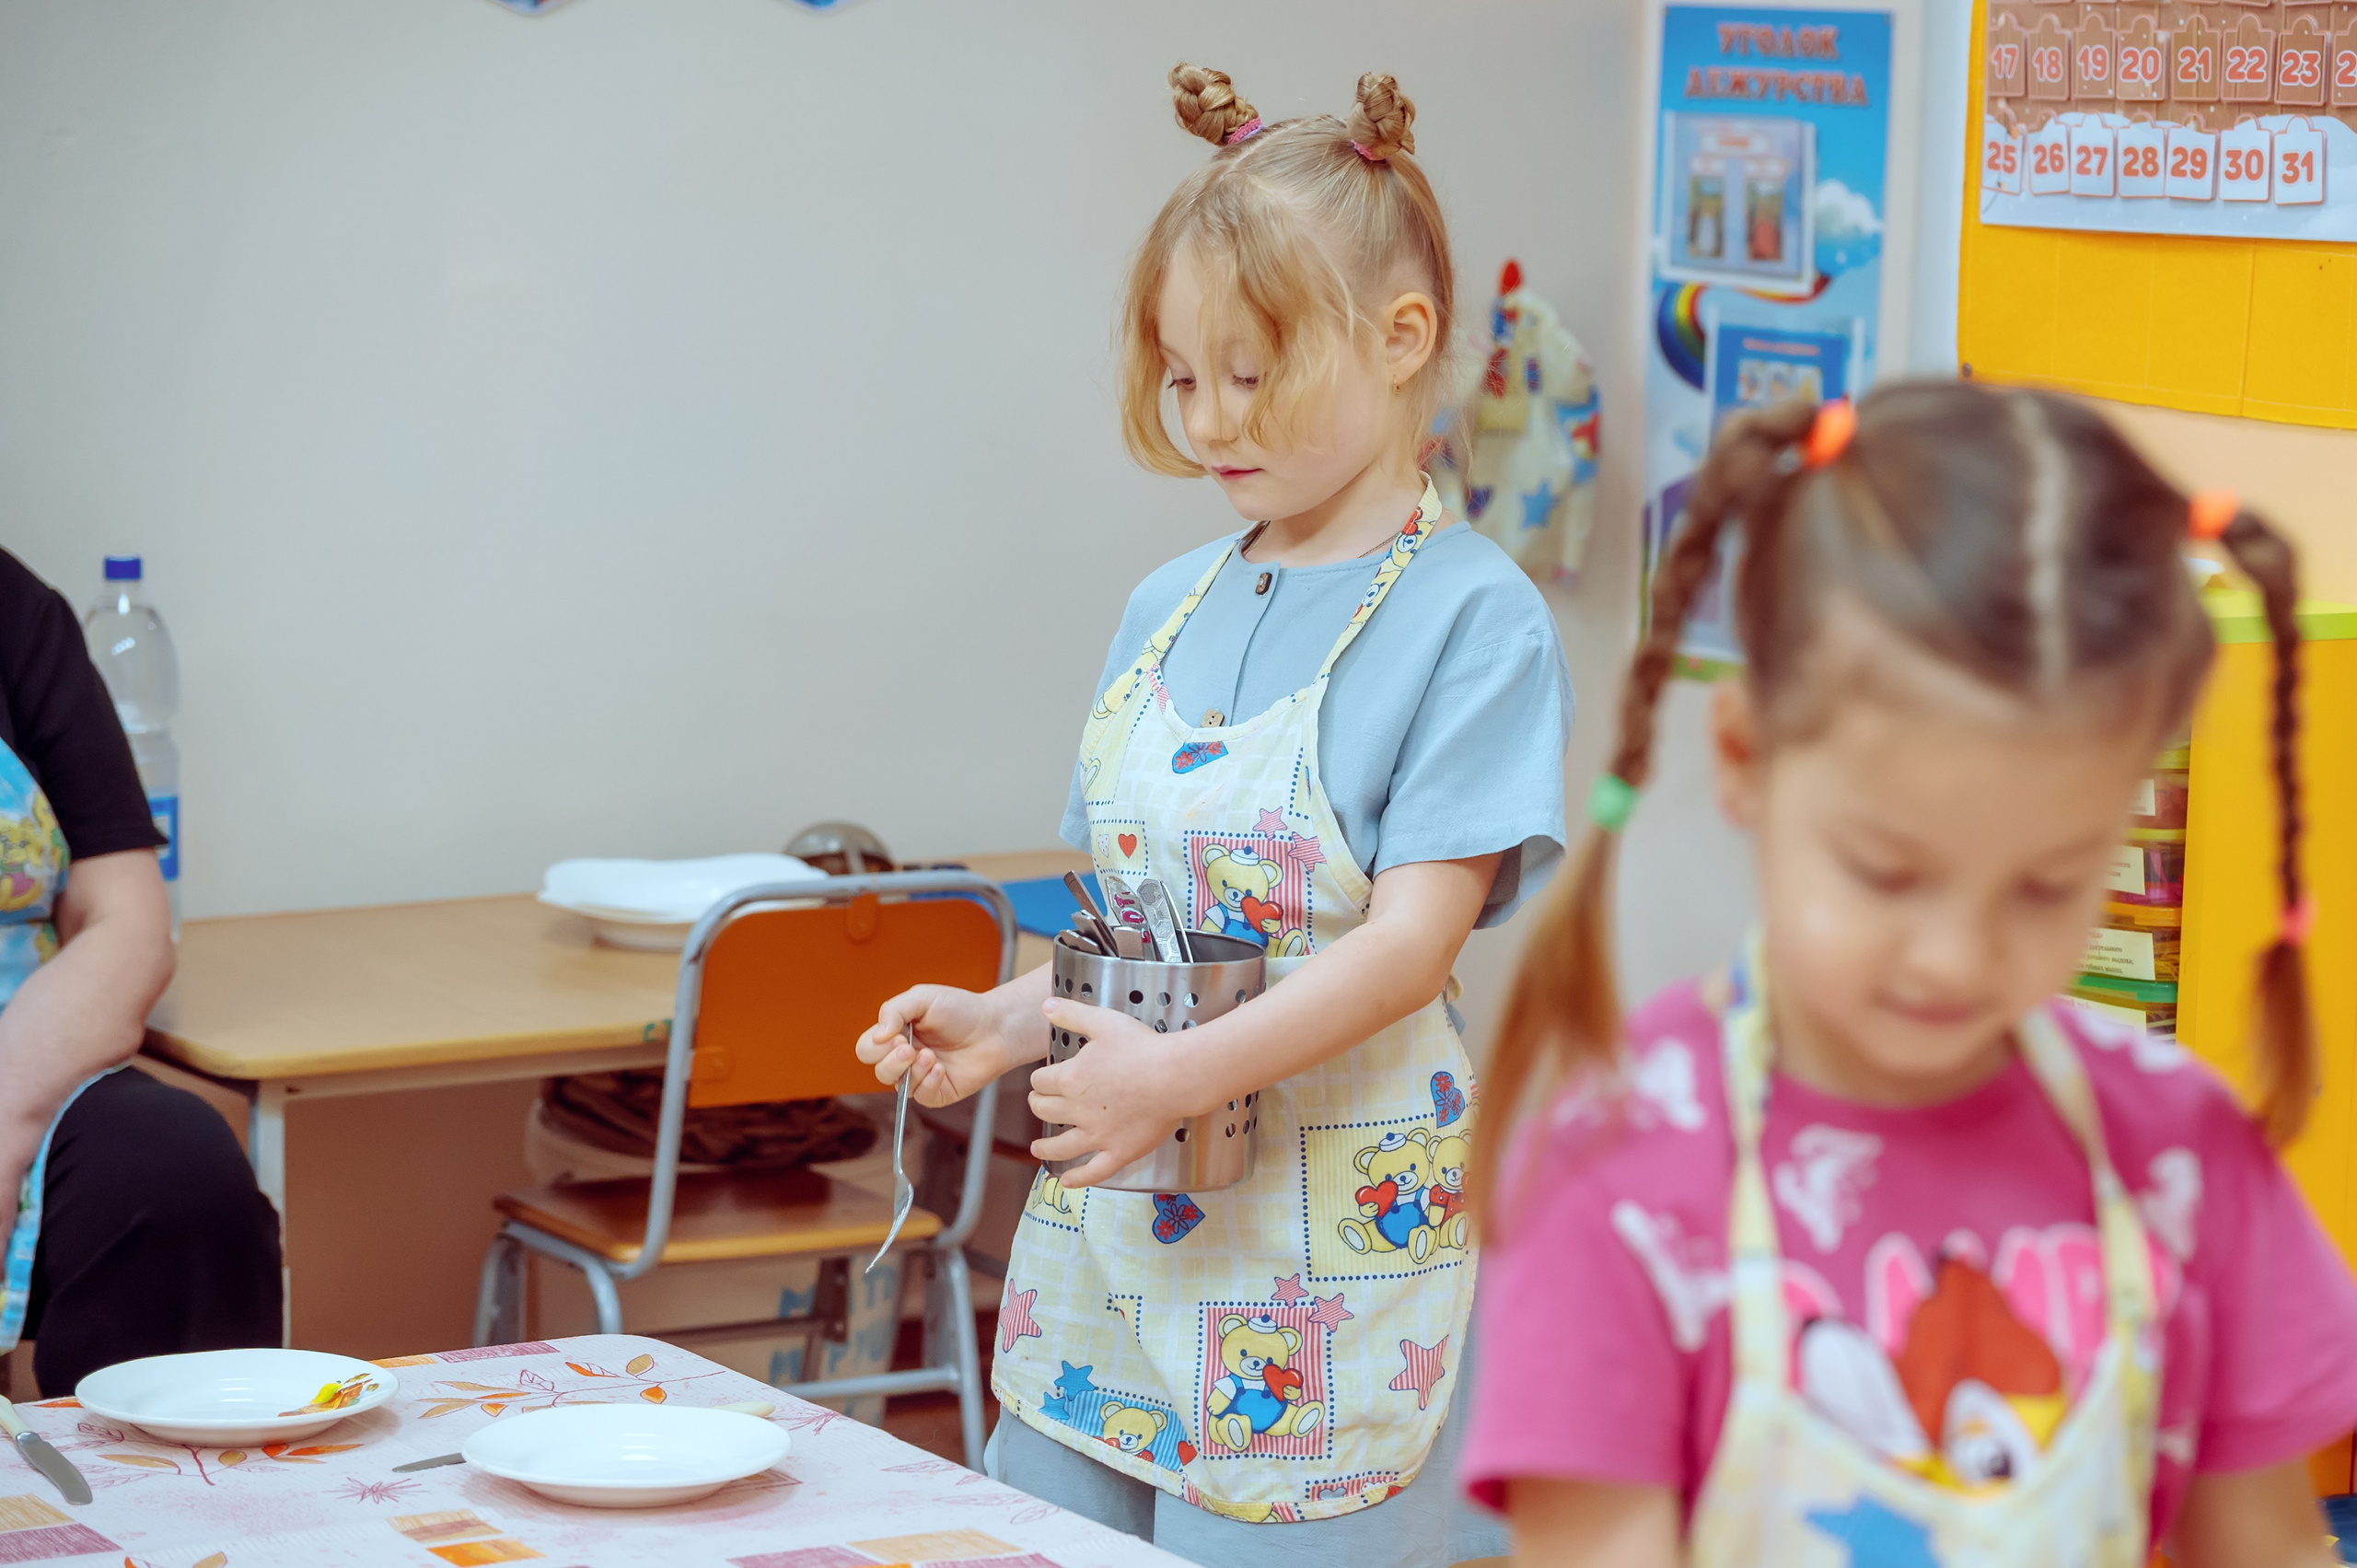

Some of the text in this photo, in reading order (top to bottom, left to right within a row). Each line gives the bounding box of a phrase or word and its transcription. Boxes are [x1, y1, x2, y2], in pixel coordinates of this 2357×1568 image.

[1718, 22, 1840, 60] УГОЛОК
[1685, 65, 1868, 106] ДЕЖУРСТВА
[1991, 44, 2357, 87] 17 18 19 20 21 22 23 2
[1987, 141, 2314, 185] 25 26 27 28 29 30 31
